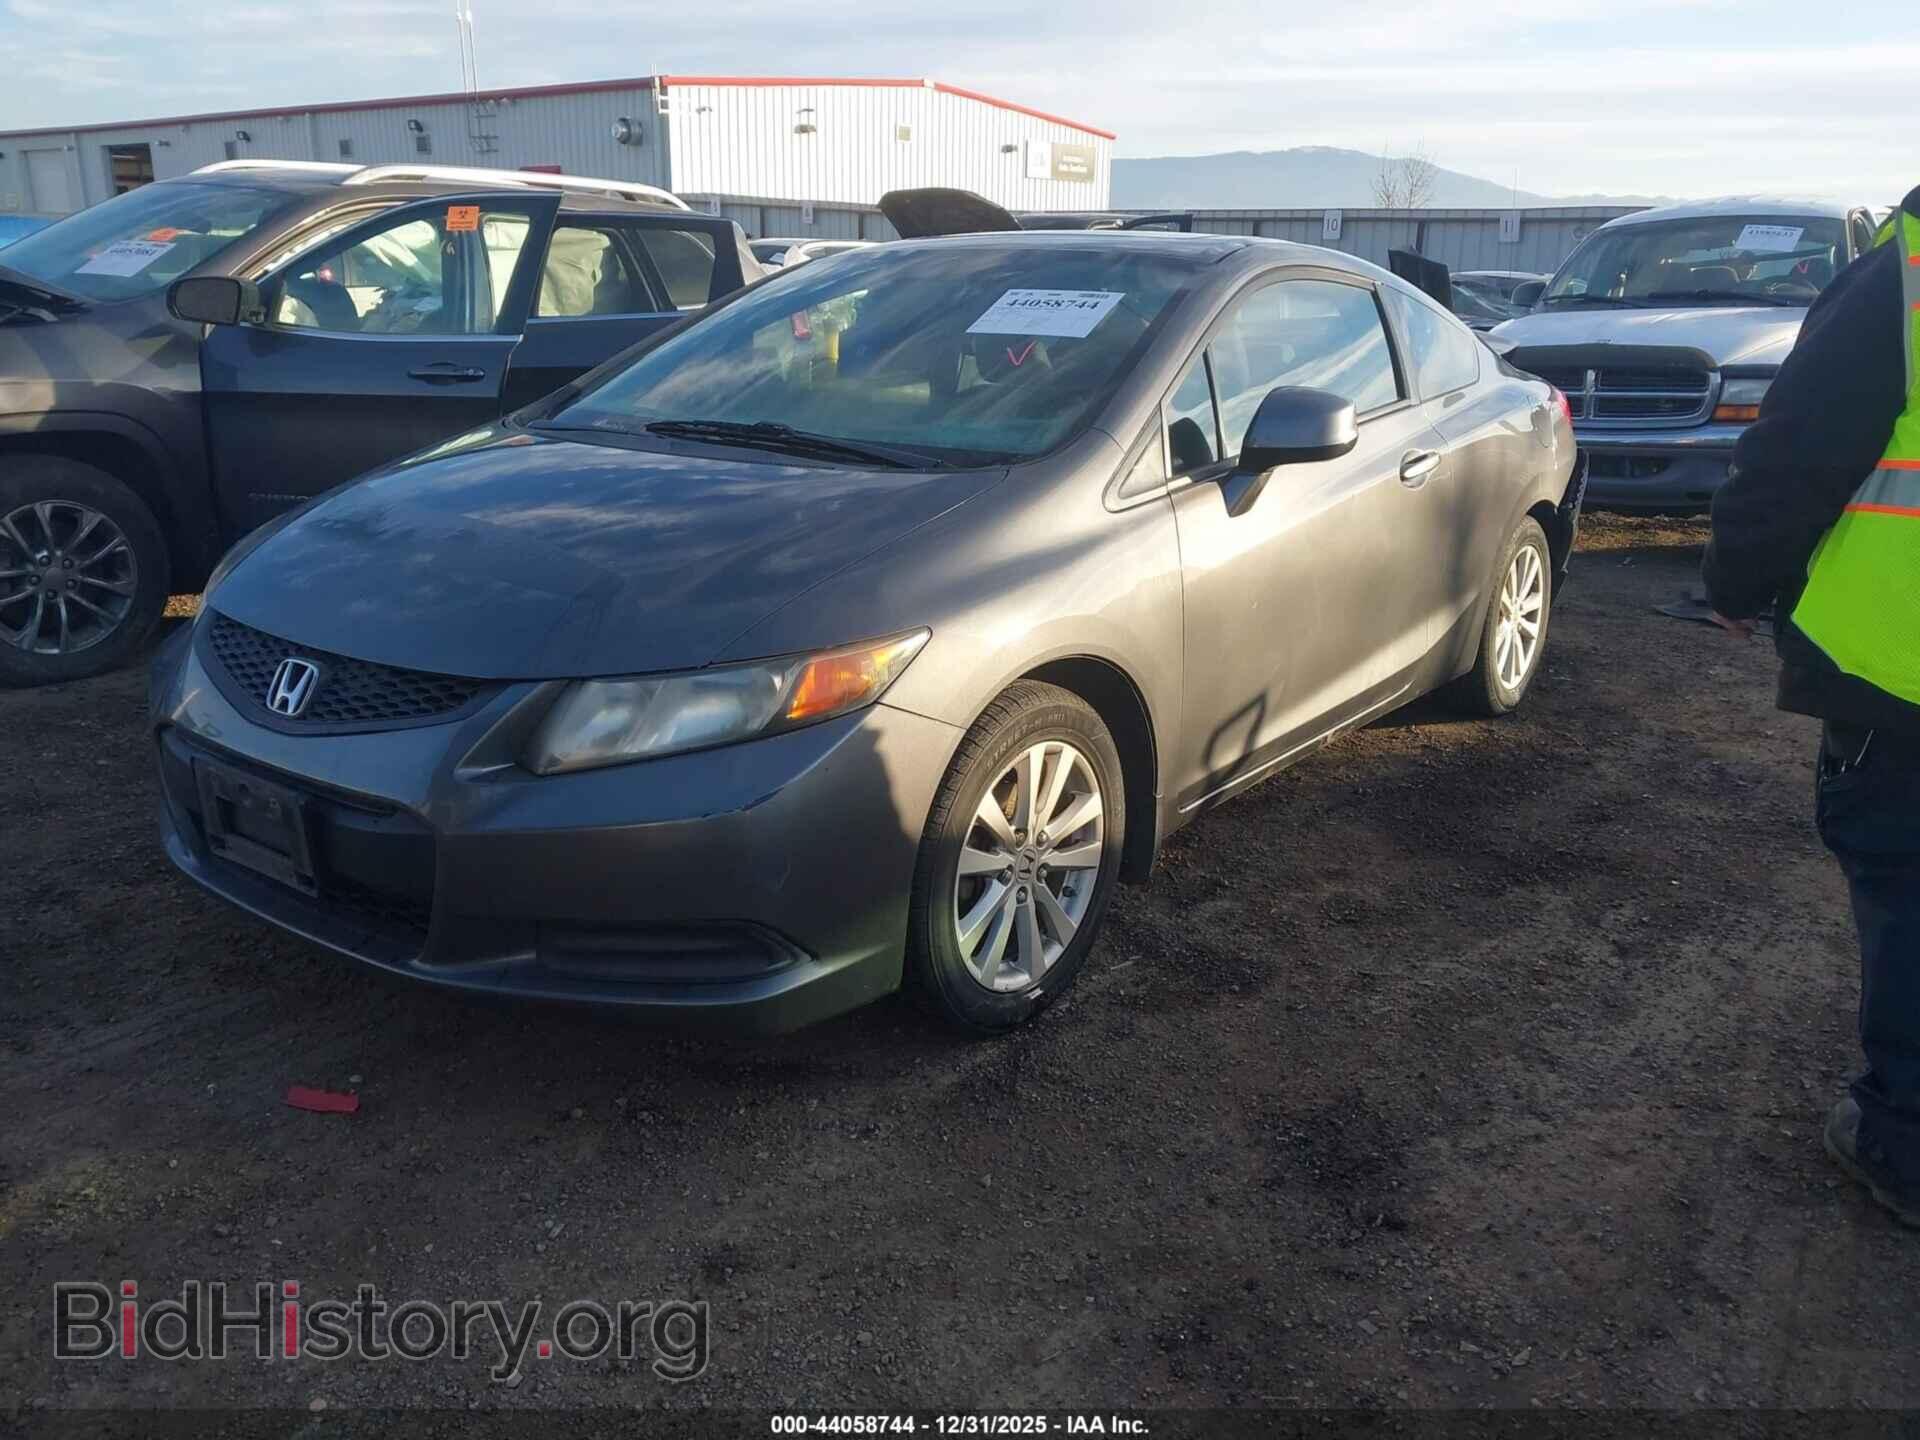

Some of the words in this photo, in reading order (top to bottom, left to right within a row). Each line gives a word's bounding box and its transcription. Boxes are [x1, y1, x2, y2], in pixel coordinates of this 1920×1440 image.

[1325, 219, 1338, 232] 10
[1504, 220, 1514, 233] 11
[1006, 299, 1101, 310] 44058744
